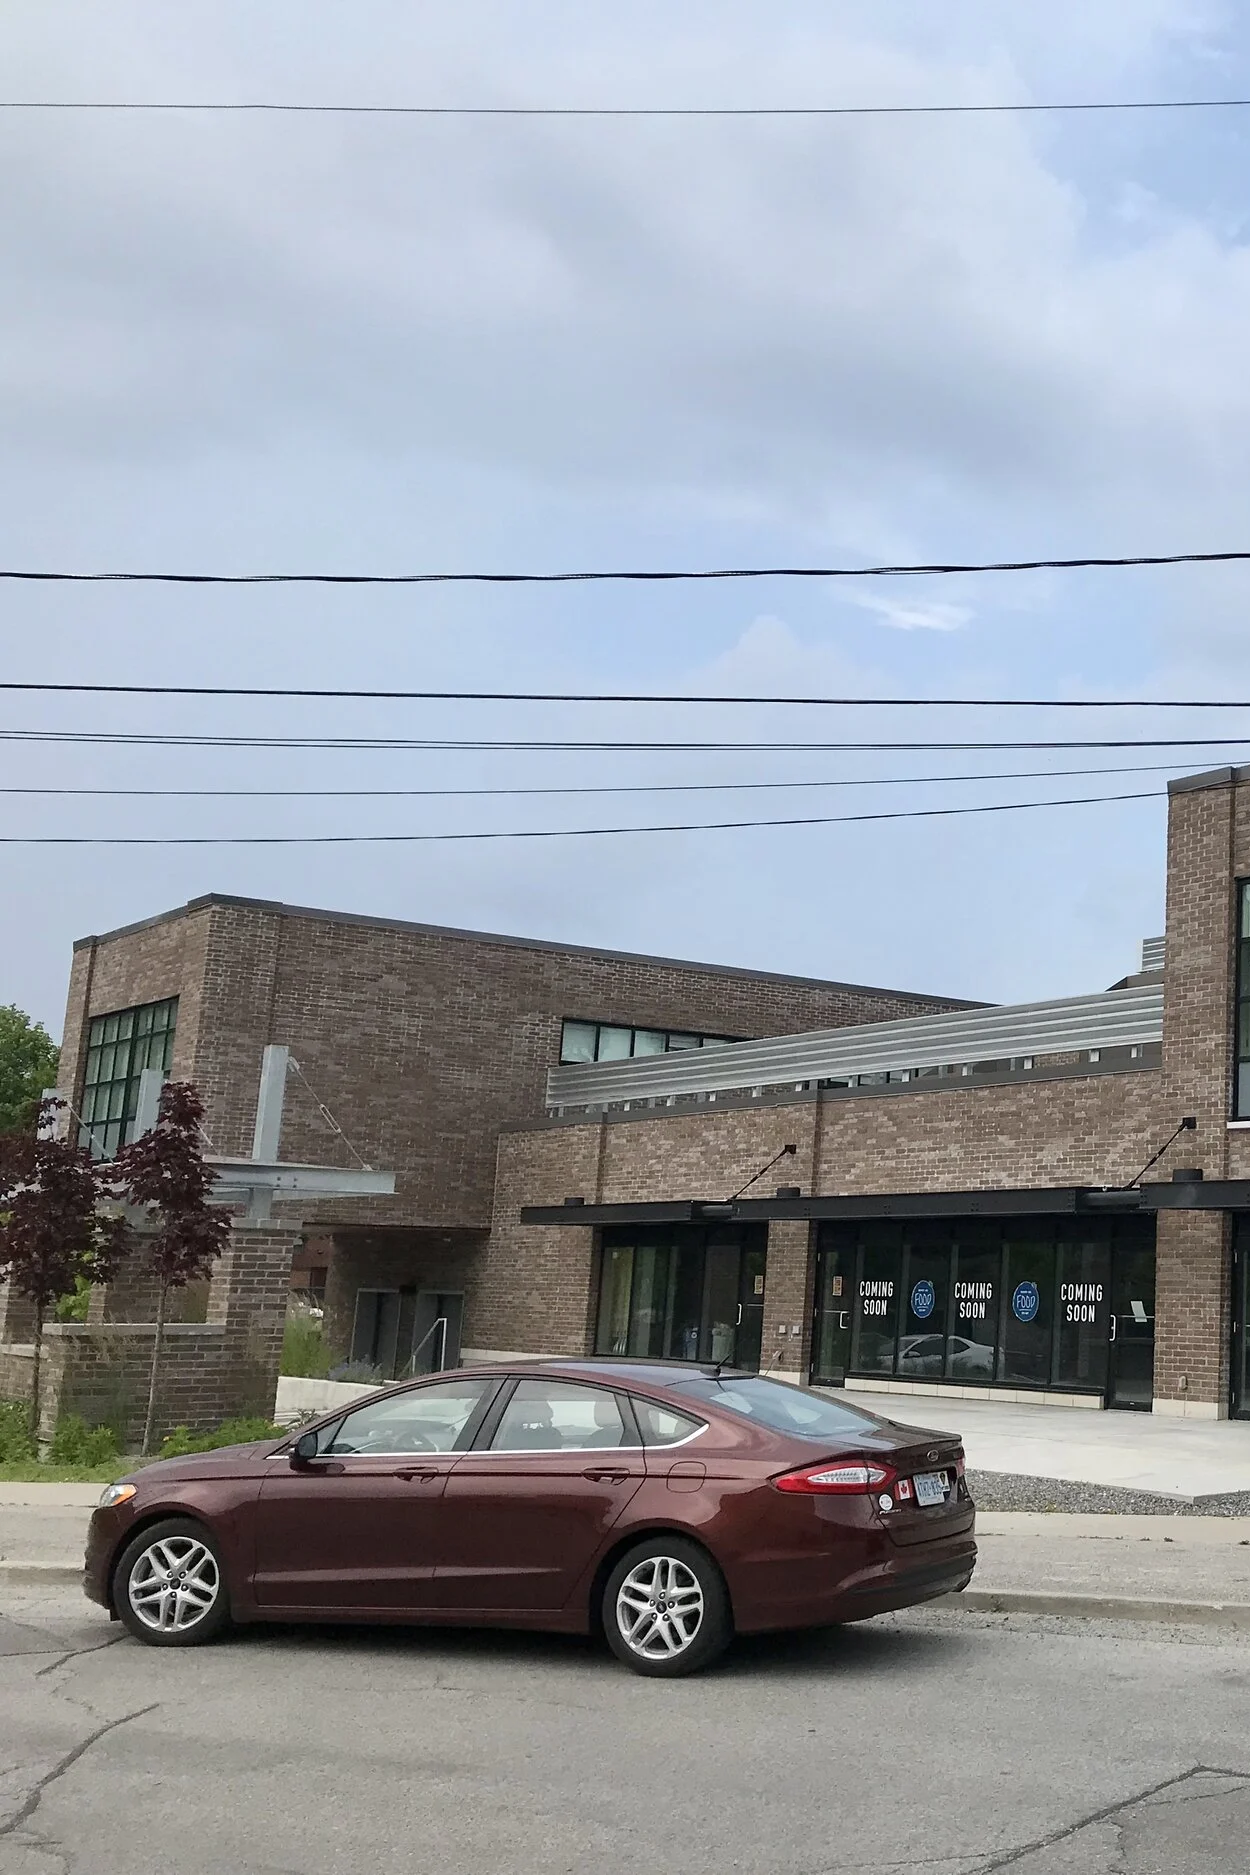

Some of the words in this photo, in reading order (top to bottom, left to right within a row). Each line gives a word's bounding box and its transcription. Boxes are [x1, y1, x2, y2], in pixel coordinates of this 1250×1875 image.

[859, 1280, 894, 1297] COMING
[954, 1282, 993, 1300] COMING
[1060, 1283, 1103, 1302] COMING
[863, 1299, 887, 1316] SOON
[959, 1301, 986, 1319] SOON
[1016, 1295, 1036, 1309] FOOD
[1066, 1304, 1095, 1323] SOON
